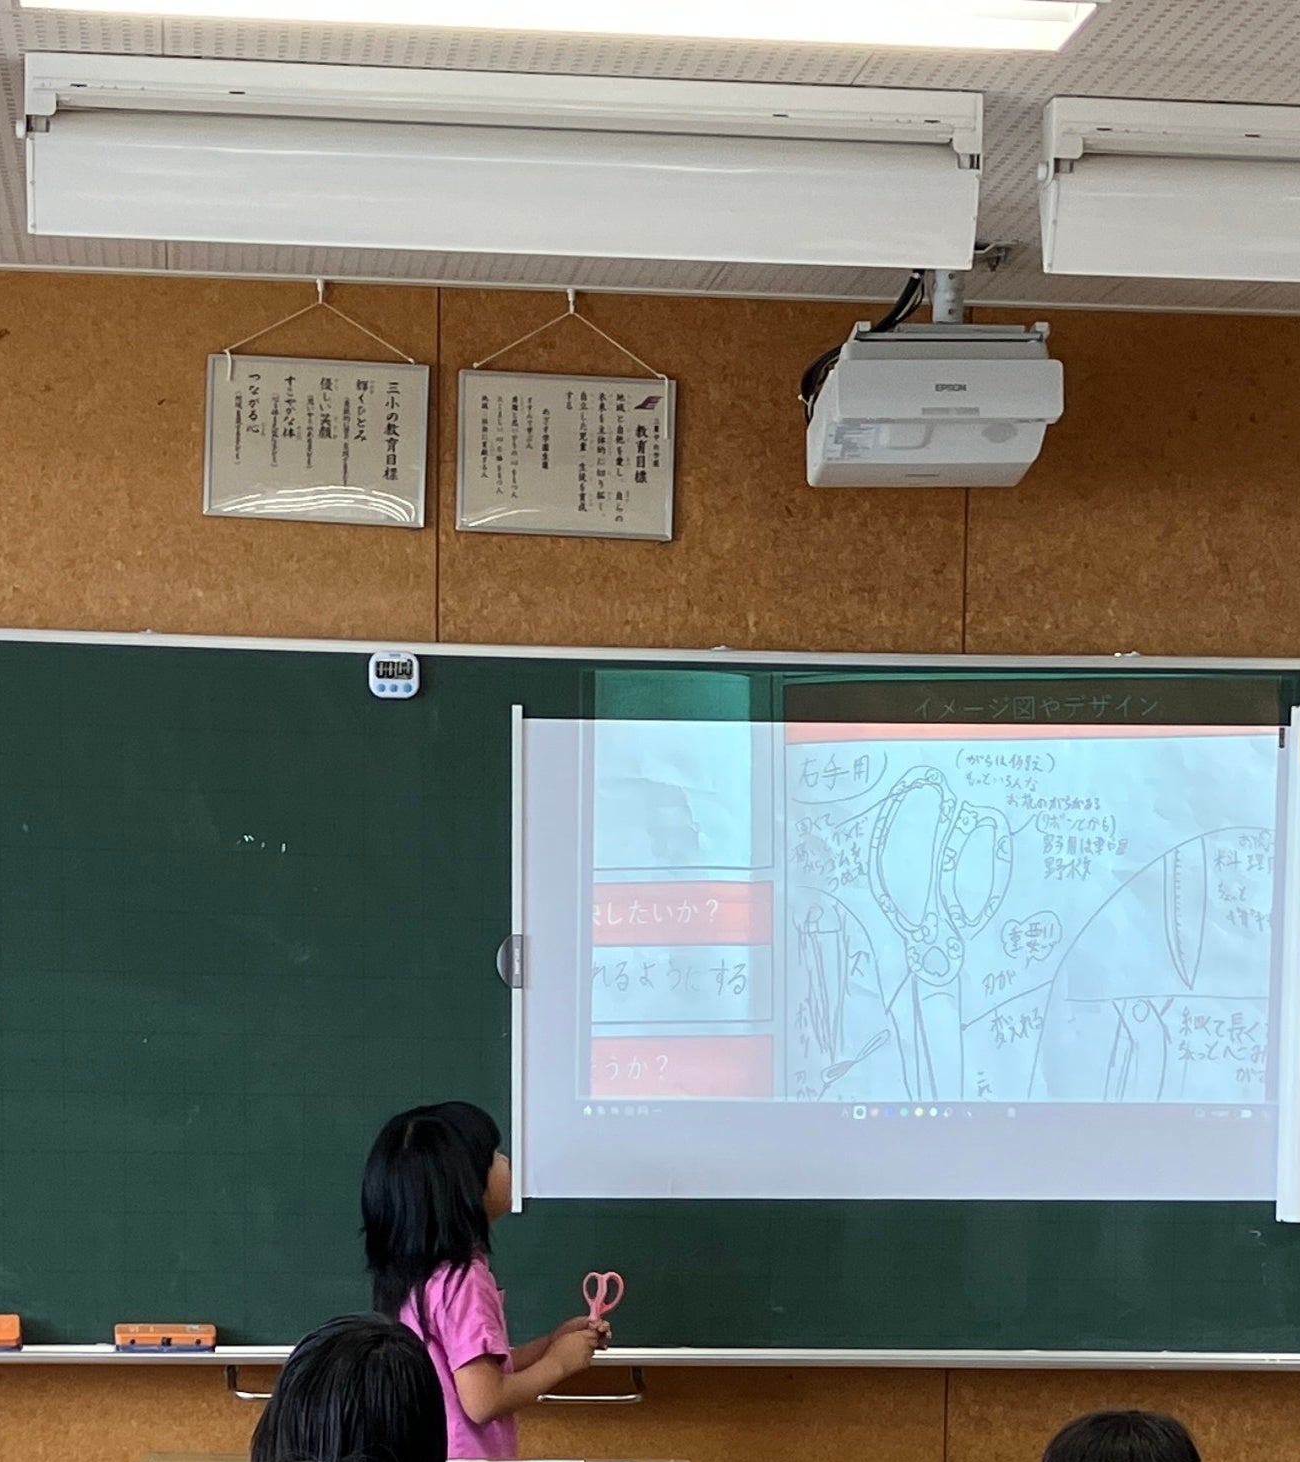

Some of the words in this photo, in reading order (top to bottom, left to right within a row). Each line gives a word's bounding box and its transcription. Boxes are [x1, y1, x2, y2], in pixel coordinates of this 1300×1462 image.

[246, 373, 261, 434] つながる心
[935, 383, 967, 392] EPSON
[382, 381, 401, 481] 三小の教育目標
[634, 423, 649, 484] 教育目標
[914, 695, 1159, 719] イメージ図やデザイン
[799, 753, 870, 791] 右手用
